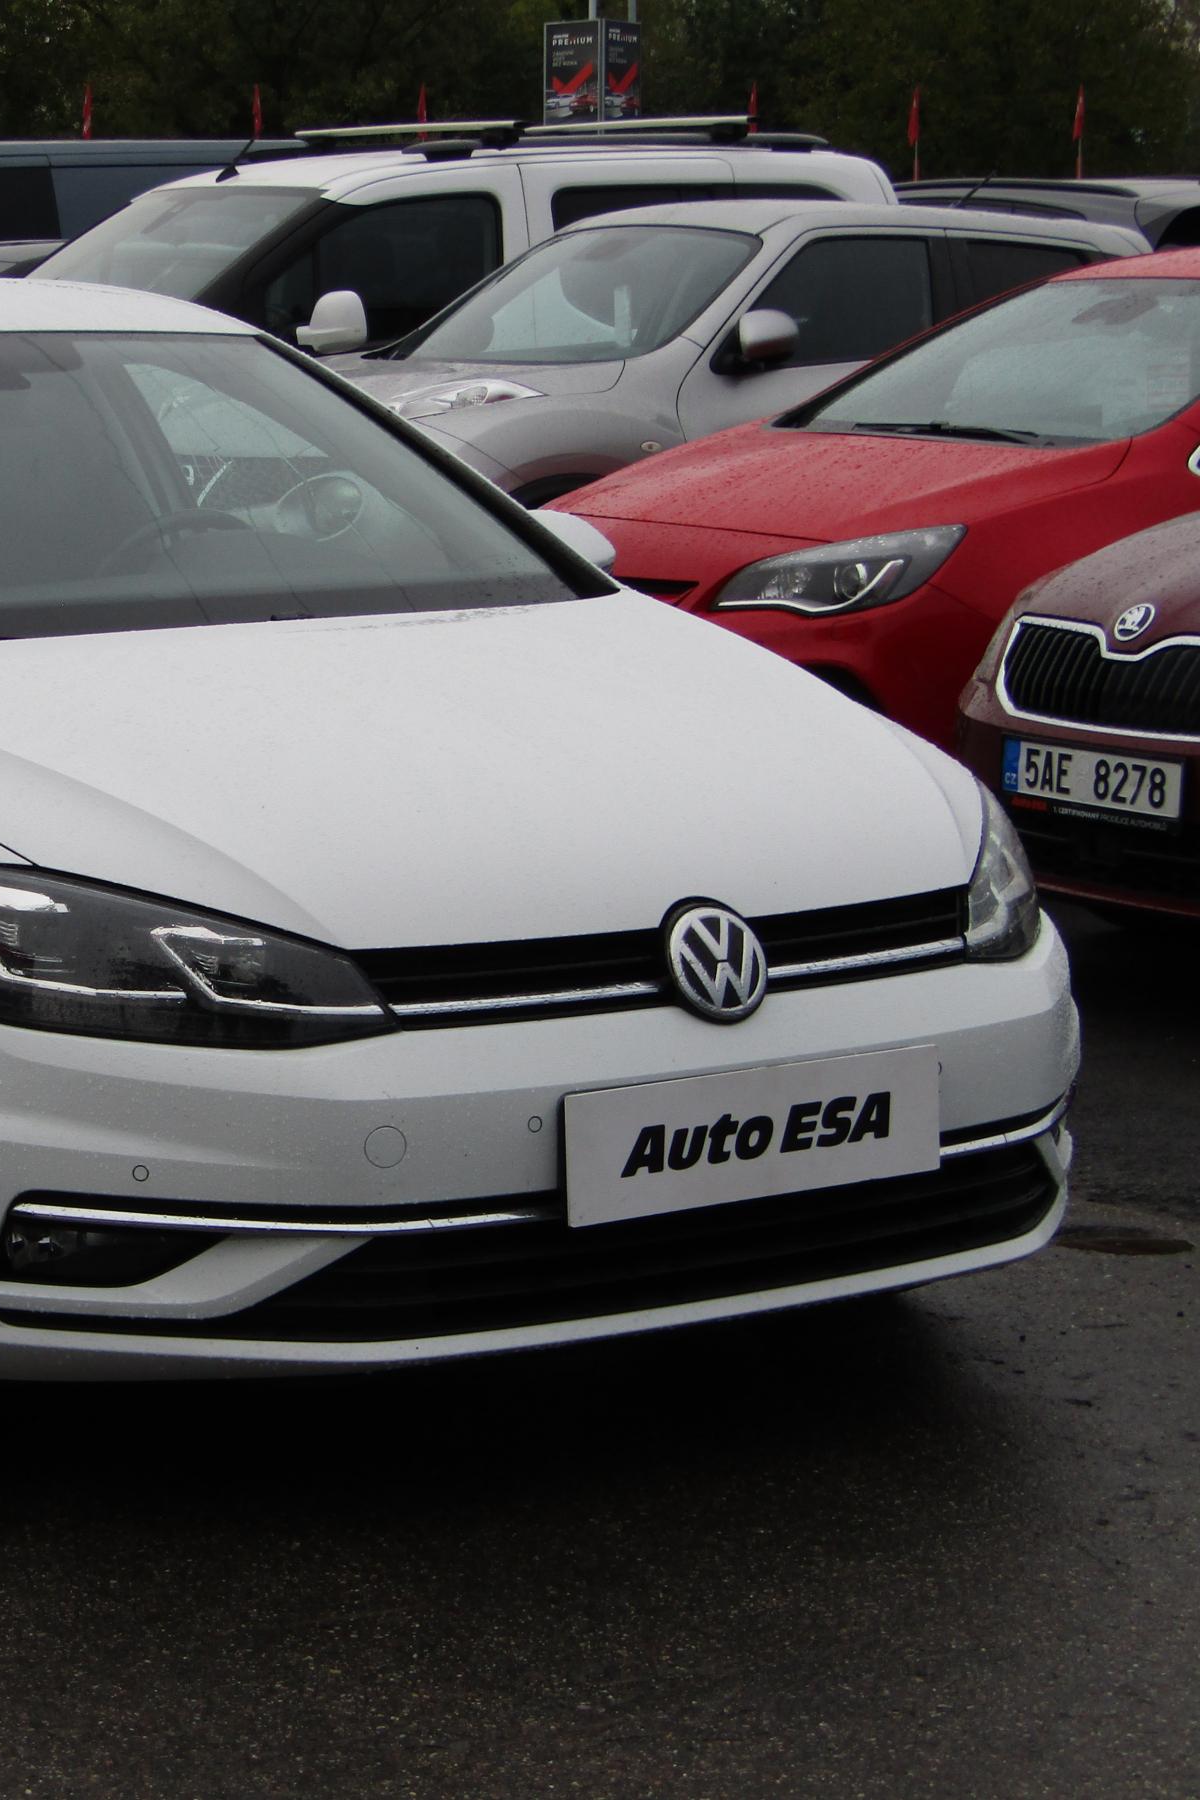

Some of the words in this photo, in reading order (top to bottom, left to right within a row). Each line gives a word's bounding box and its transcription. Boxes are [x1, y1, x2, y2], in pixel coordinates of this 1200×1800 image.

[552, 37, 593, 46] PREMIUM
[1004, 772, 1017, 785] CZ
[1025, 748, 1073, 795] 5AE
[1093, 759, 1167, 809] 8278
[620, 1113, 774, 1179] Auto
[779, 1091, 891, 1154] ESA
